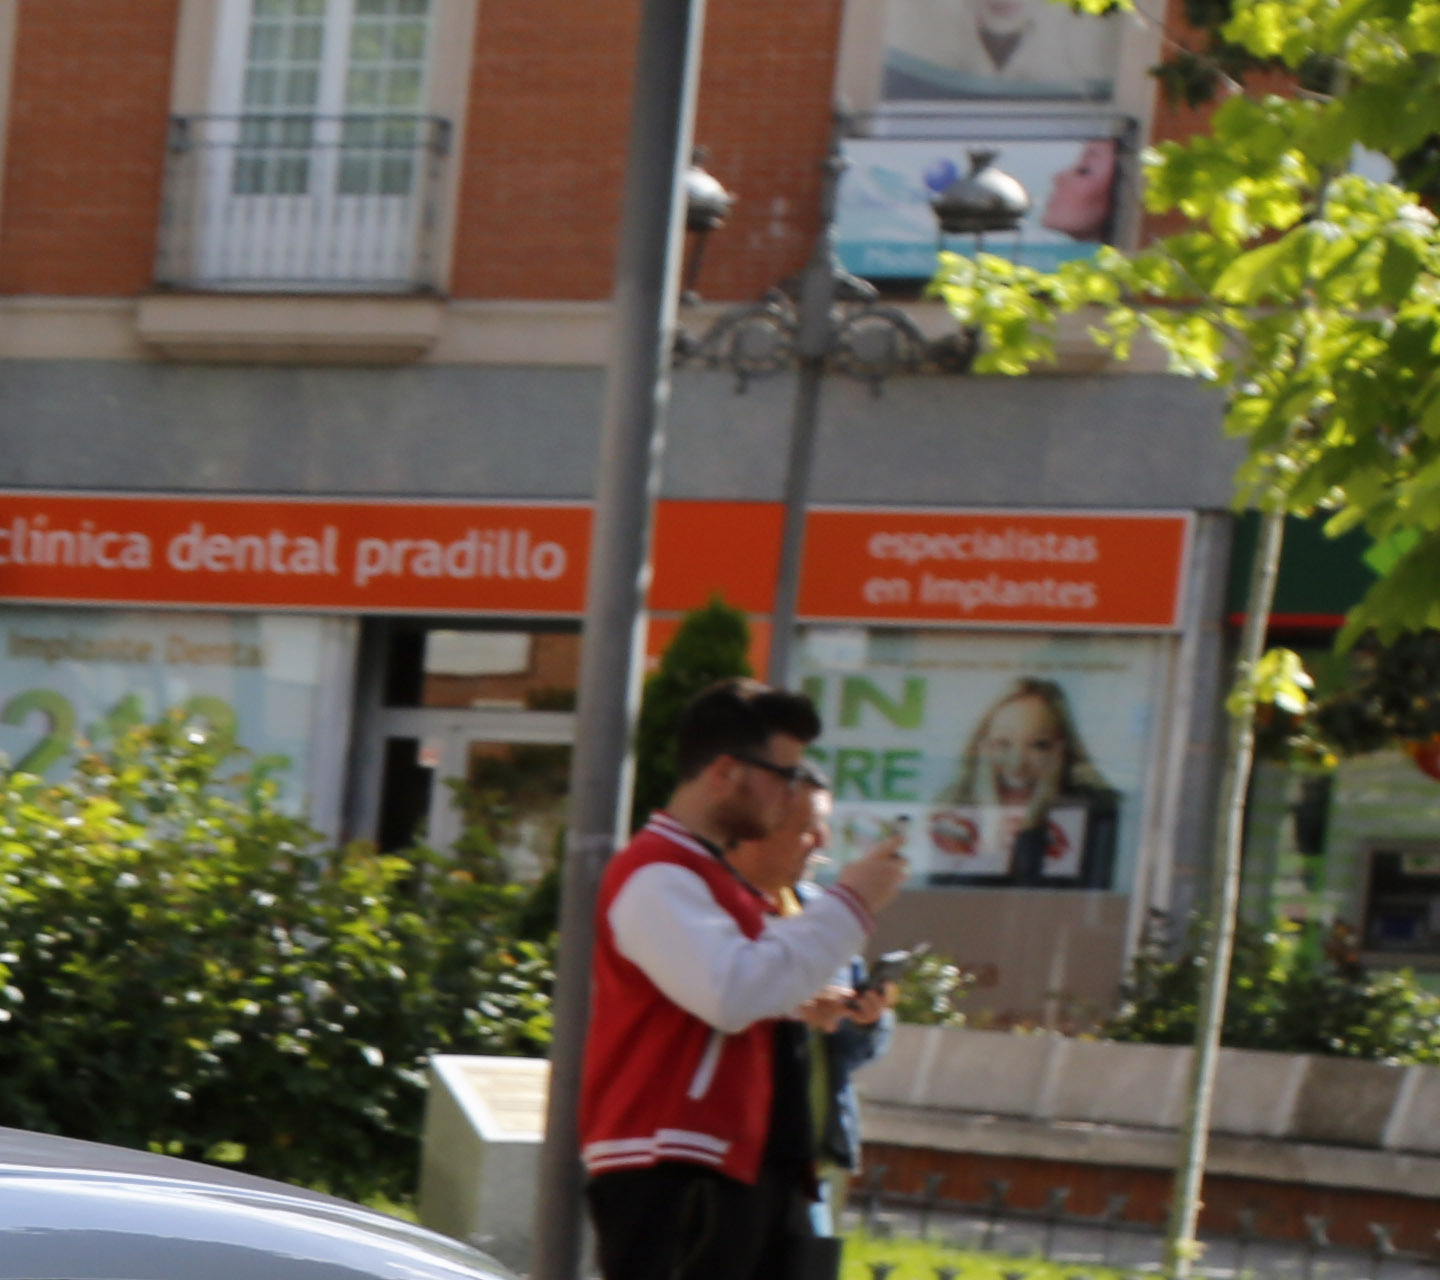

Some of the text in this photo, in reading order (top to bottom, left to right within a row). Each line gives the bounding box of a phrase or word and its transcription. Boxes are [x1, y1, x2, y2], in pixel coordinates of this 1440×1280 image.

[167, 521, 338, 576] dental
[354, 528, 568, 586] pradillo
[866, 528, 1100, 564] especialistas
[862, 577, 911, 605] en
